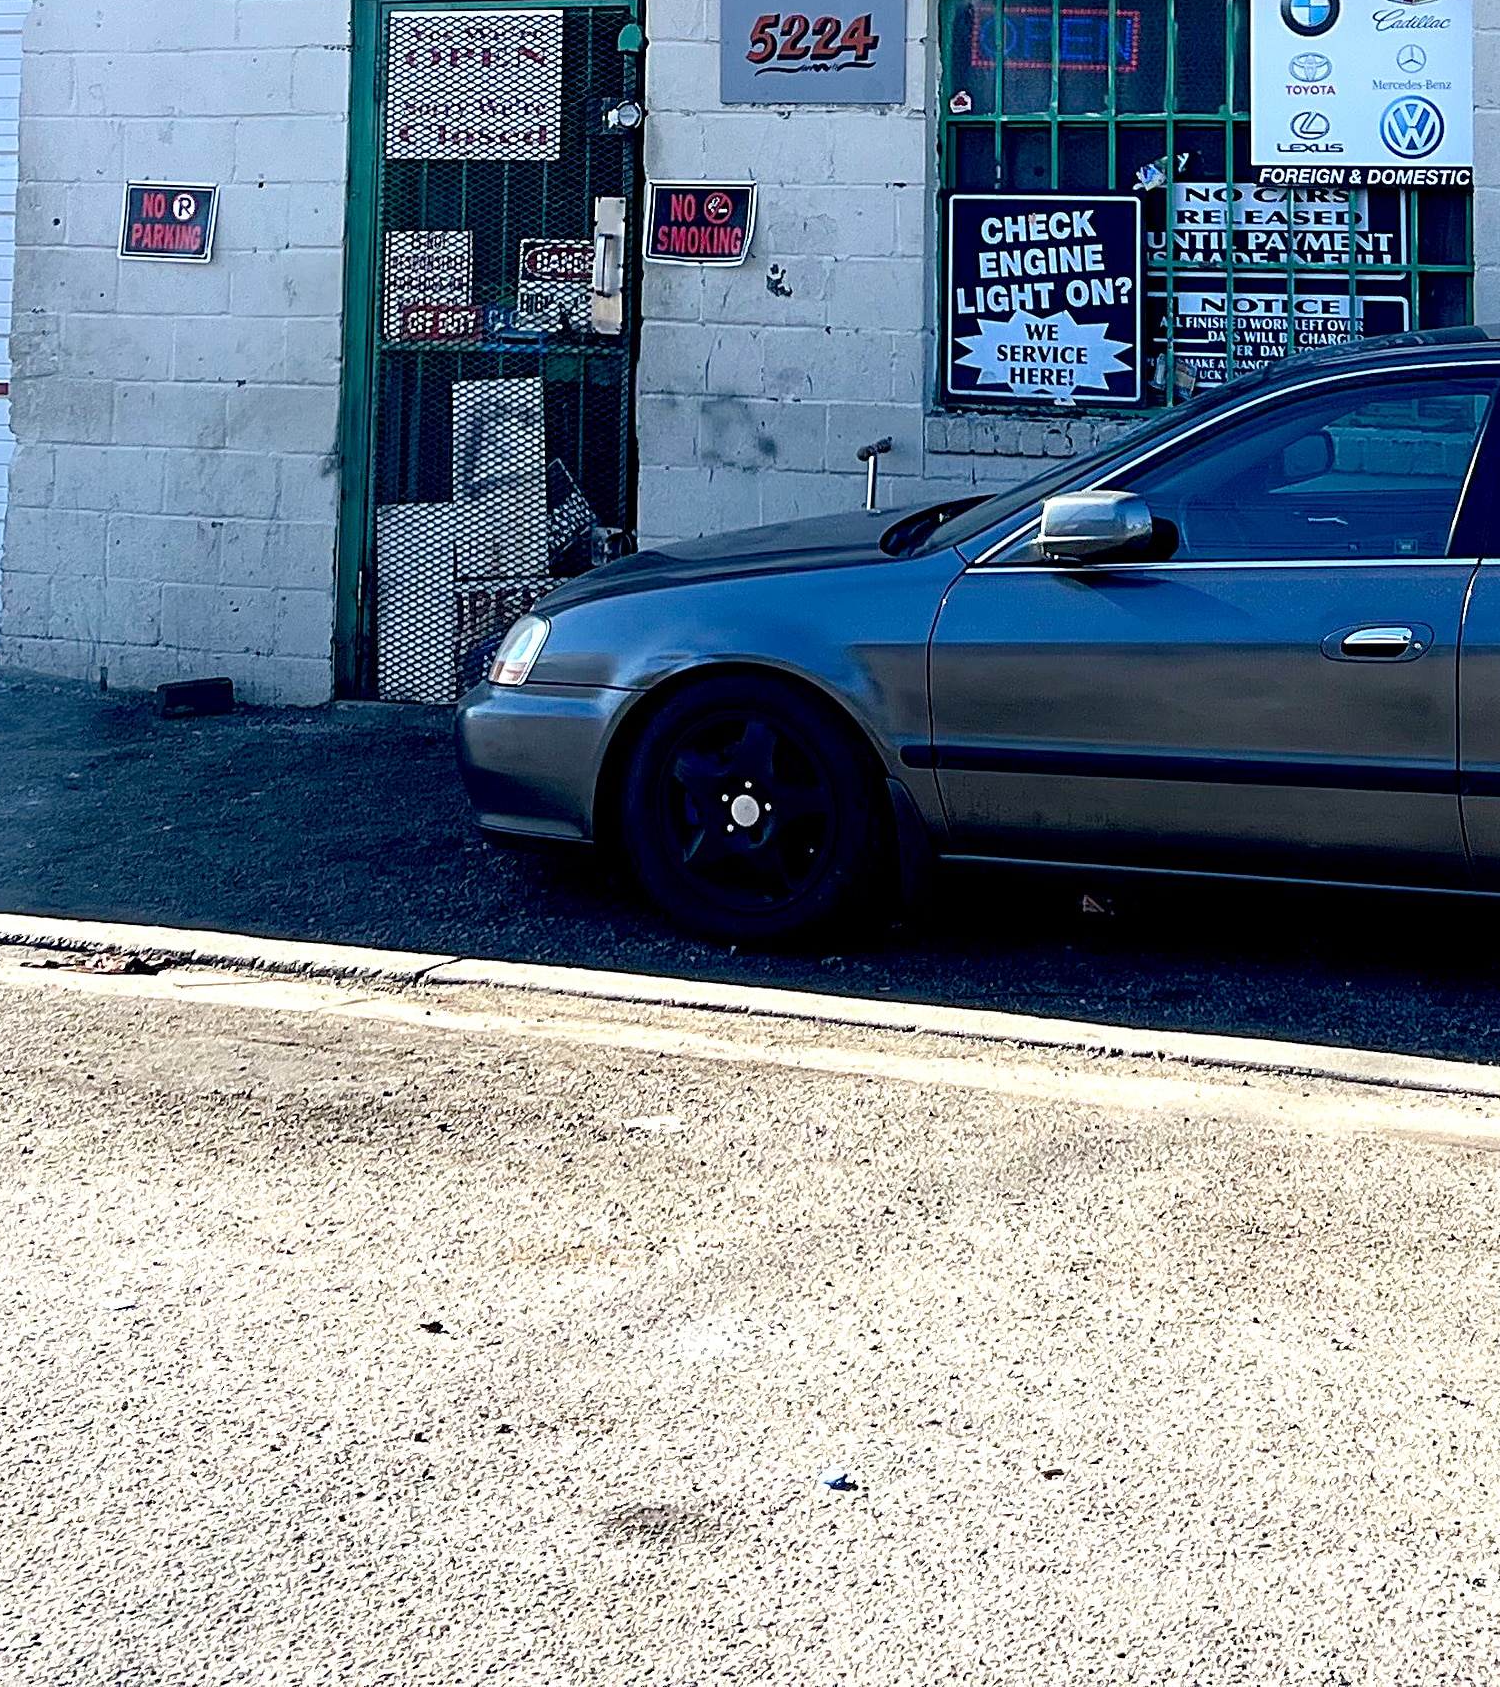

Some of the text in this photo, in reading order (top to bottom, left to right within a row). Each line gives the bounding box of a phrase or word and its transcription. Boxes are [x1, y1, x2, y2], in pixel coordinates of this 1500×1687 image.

[1372, 8, 1452, 32] Cadillac
[745, 13, 880, 64] 5224
[980, 16, 1132, 61] OPEN
[1285, 85, 1336, 96] TOYOTA
[1372, 79, 1452, 91] Mercedes-Benz
[1276, 142, 1344, 153] LEXUS
[1258, 168, 1471, 186] FOREIGN & DOMESTIC
[1185, 187, 1243, 203] NO
[143, 193, 166, 219] NO
[670, 193, 696, 222] NO
[130, 223, 202, 251] PARKING
[980, 209, 1097, 245] CHECK
[657, 225, 742, 255] SMOKING
[978, 244, 1106, 279] ENGINE
[956, 276, 1133, 314] LIGHT ON?
[1201, 297, 1341, 315] NOTICE
[1024, 323, 1059, 342] WE
[1208, 330, 1241, 343] DAS
[1243, 331, 1276, 344] WILL
[996, 344, 1089, 364] SERVICE
[1260, 345, 1286, 358] DAY
[1009, 368, 1075, 386] HERE!
